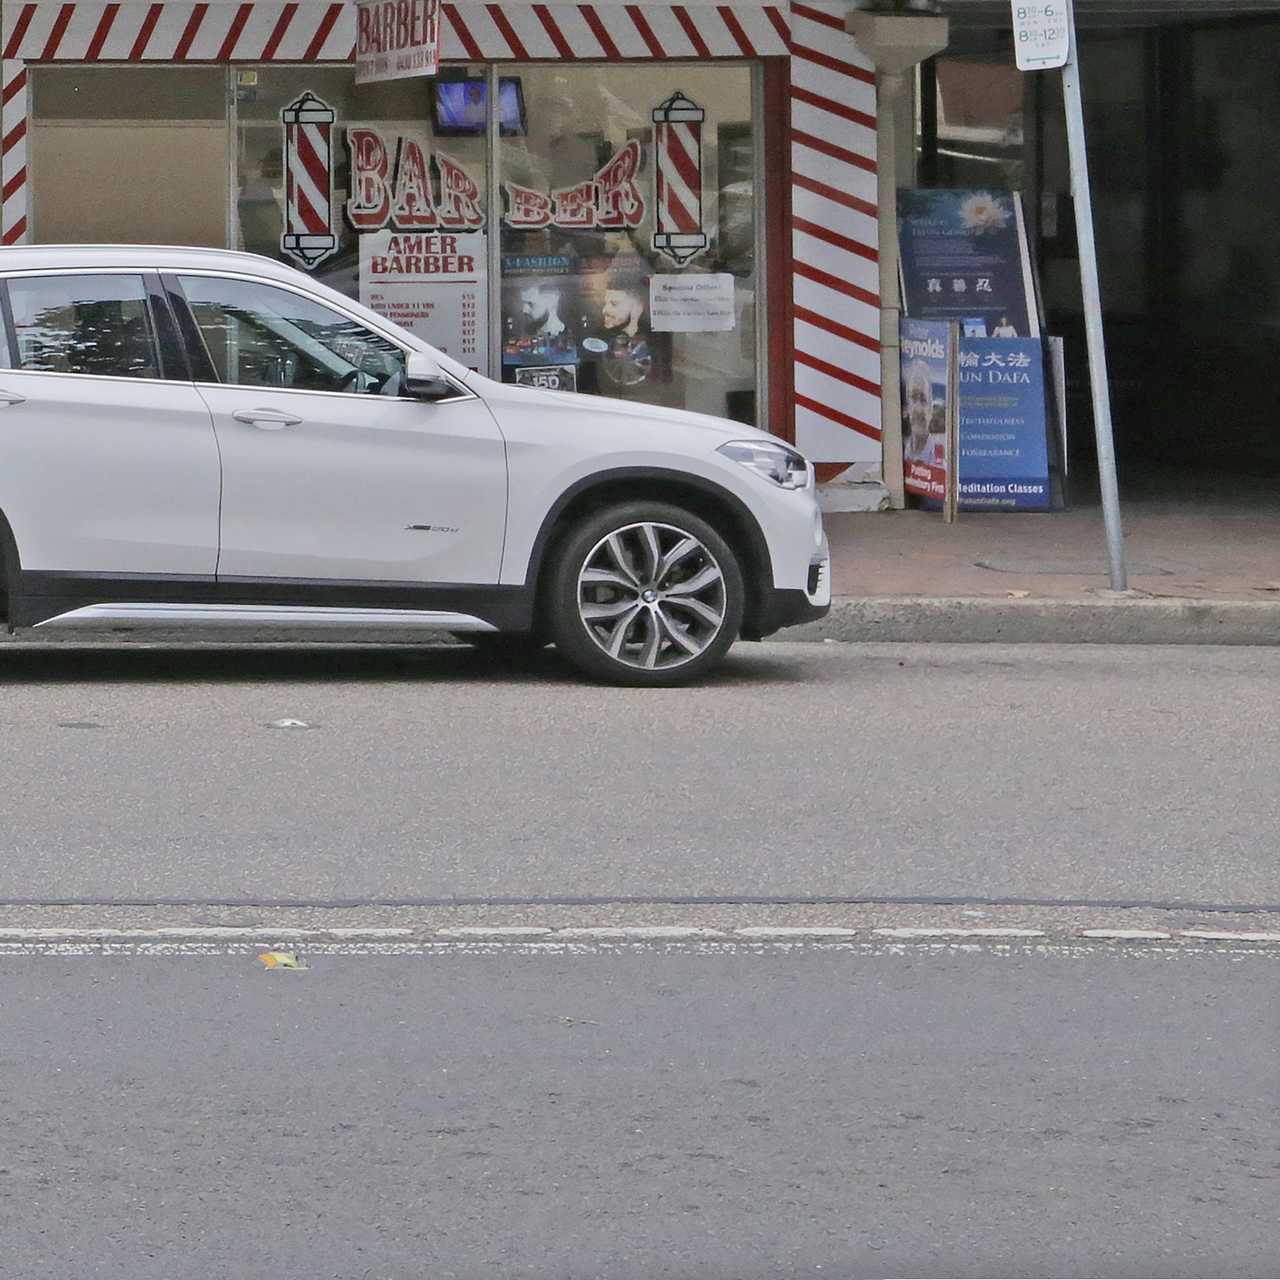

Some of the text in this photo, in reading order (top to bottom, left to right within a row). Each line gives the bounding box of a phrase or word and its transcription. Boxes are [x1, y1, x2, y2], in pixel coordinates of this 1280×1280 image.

[387, 235, 457, 255] AMER
[371, 255, 475, 274] BARBER
[902, 339, 945, 359] eynolds
[959, 352, 1031, 367] 輪大法
[959, 371, 982, 384] UN
[1007, 483, 1044, 494] Classes
